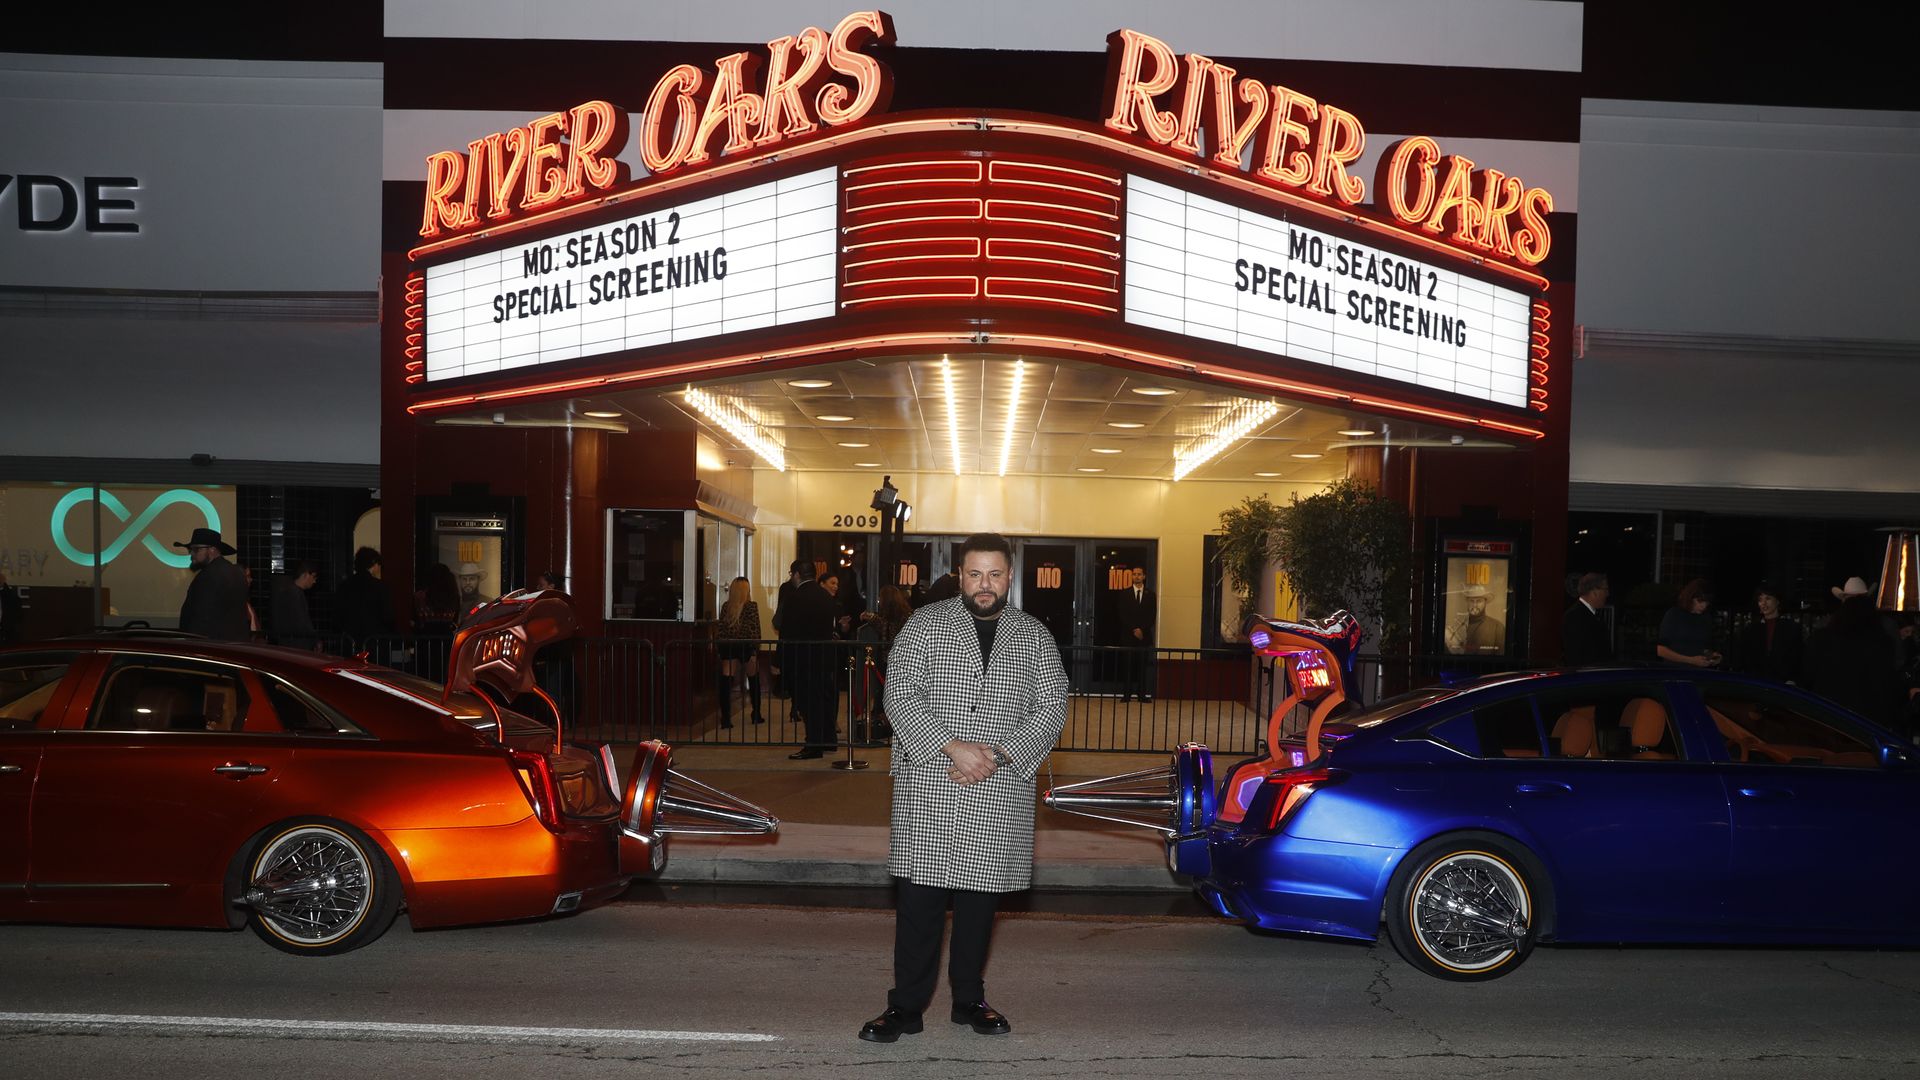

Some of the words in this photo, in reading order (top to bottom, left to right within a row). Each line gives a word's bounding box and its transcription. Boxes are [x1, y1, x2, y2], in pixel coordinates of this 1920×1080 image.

[419, 100, 618, 238] RIVER
[639, 10, 885, 174] OAKS
[1104, 28, 1366, 205] RIVER
[1387, 136, 1554, 266] OAKS
[0, 174, 140, 233] DE
[523, 243, 560, 279] MO:
[566, 217, 657, 269] SEASON
[667, 211, 681, 246] 2
[1336, 244, 1421, 297] SEASON
[1427, 271, 1438, 301] 2
[493, 279, 577, 324] SPECIAL
[588, 246, 728, 306] SCREENING
[1235, 258, 1337, 315] SPECIAL
[1347, 289, 1467, 348] SCREENING
[833, 514, 878, 528] 2009
[1036, 567, 1062, 589] MO
[1108, 569, 1133, 590] MO
